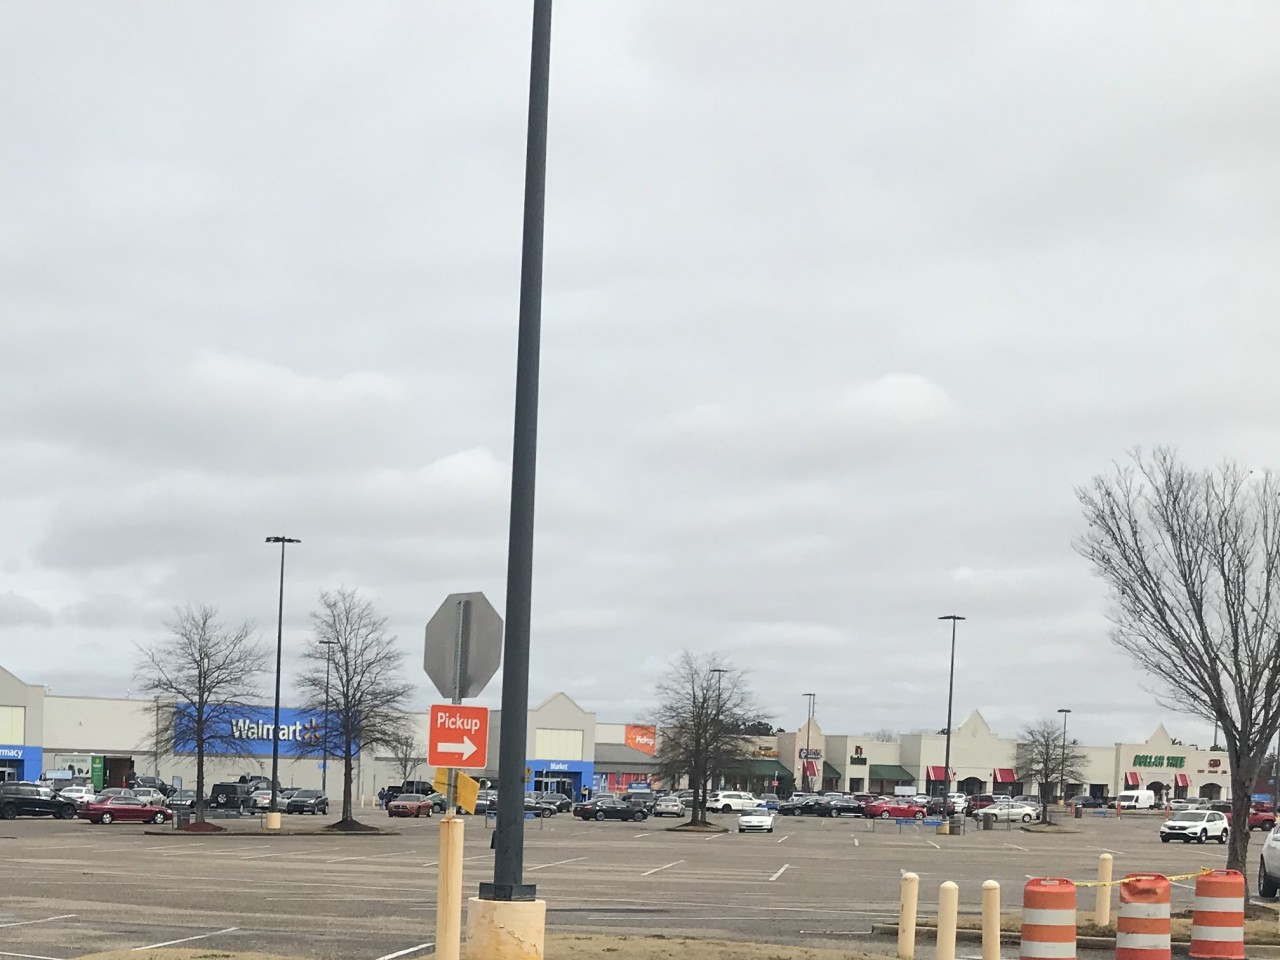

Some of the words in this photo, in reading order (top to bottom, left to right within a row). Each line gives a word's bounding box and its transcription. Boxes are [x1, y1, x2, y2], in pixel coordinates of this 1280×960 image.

[232, 719, 302, 740] Walmart
[437, 712, 480, 735] Pickup
[635, 735, 654, 746] Pickup
[1133, 755, 1165, 767] DOLLAR
